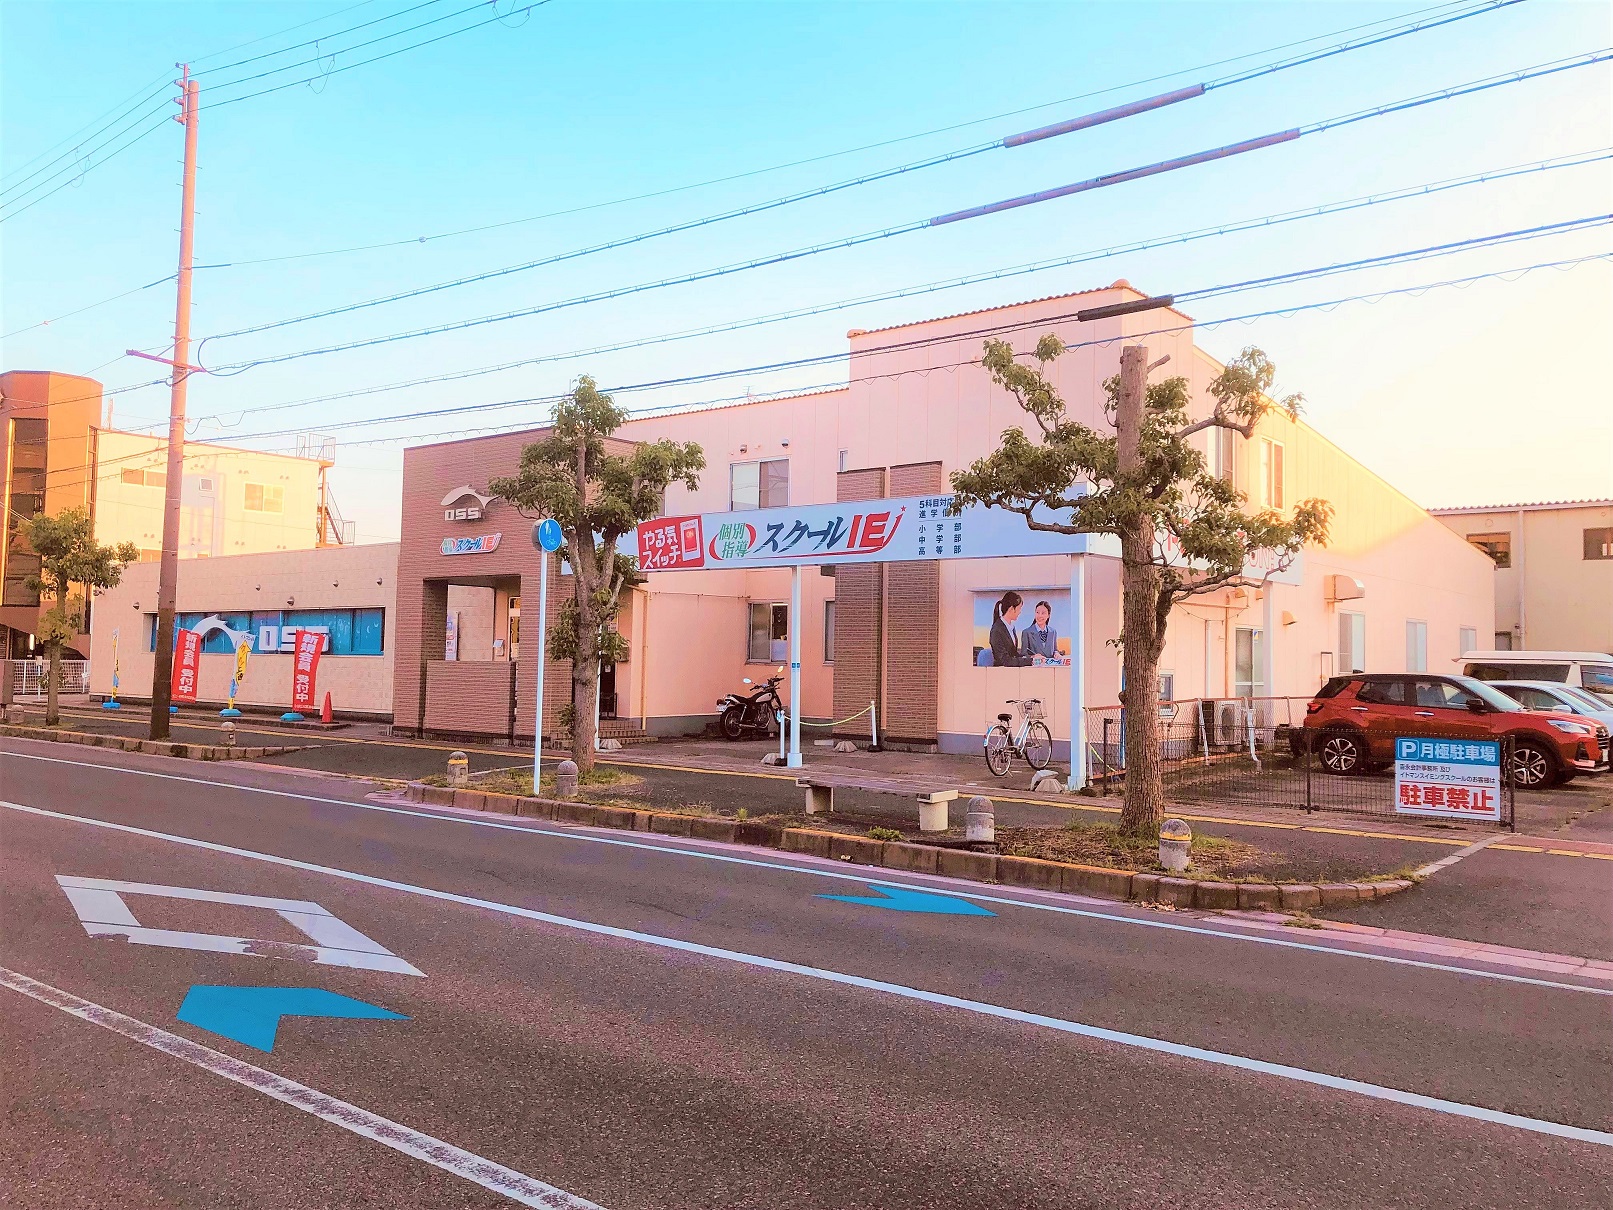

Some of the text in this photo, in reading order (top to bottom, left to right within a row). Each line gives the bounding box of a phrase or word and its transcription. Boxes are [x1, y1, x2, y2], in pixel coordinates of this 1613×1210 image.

[445, 507, 480, 521] OSS
[643, 525, 678, 550] やる気
[719, 522, 746, 541] 個別
[919, 523, 962, 533] 小学部
[919, 534, 962, 544] 中学部
[642, 545, 681, 569] スイッチ
[721, 540, 749, 558] 指導
[919, 545, 962, 556] 高等部
[178, 668, 195, 694] 受付中
[296, 674, 310, 702] 受付中
[1402, 742, 1496, 762] P 月極駐車場
[1439, 765, 1451, 773] 及び
[1399, 784, 1496, 812] 駐車禁止
